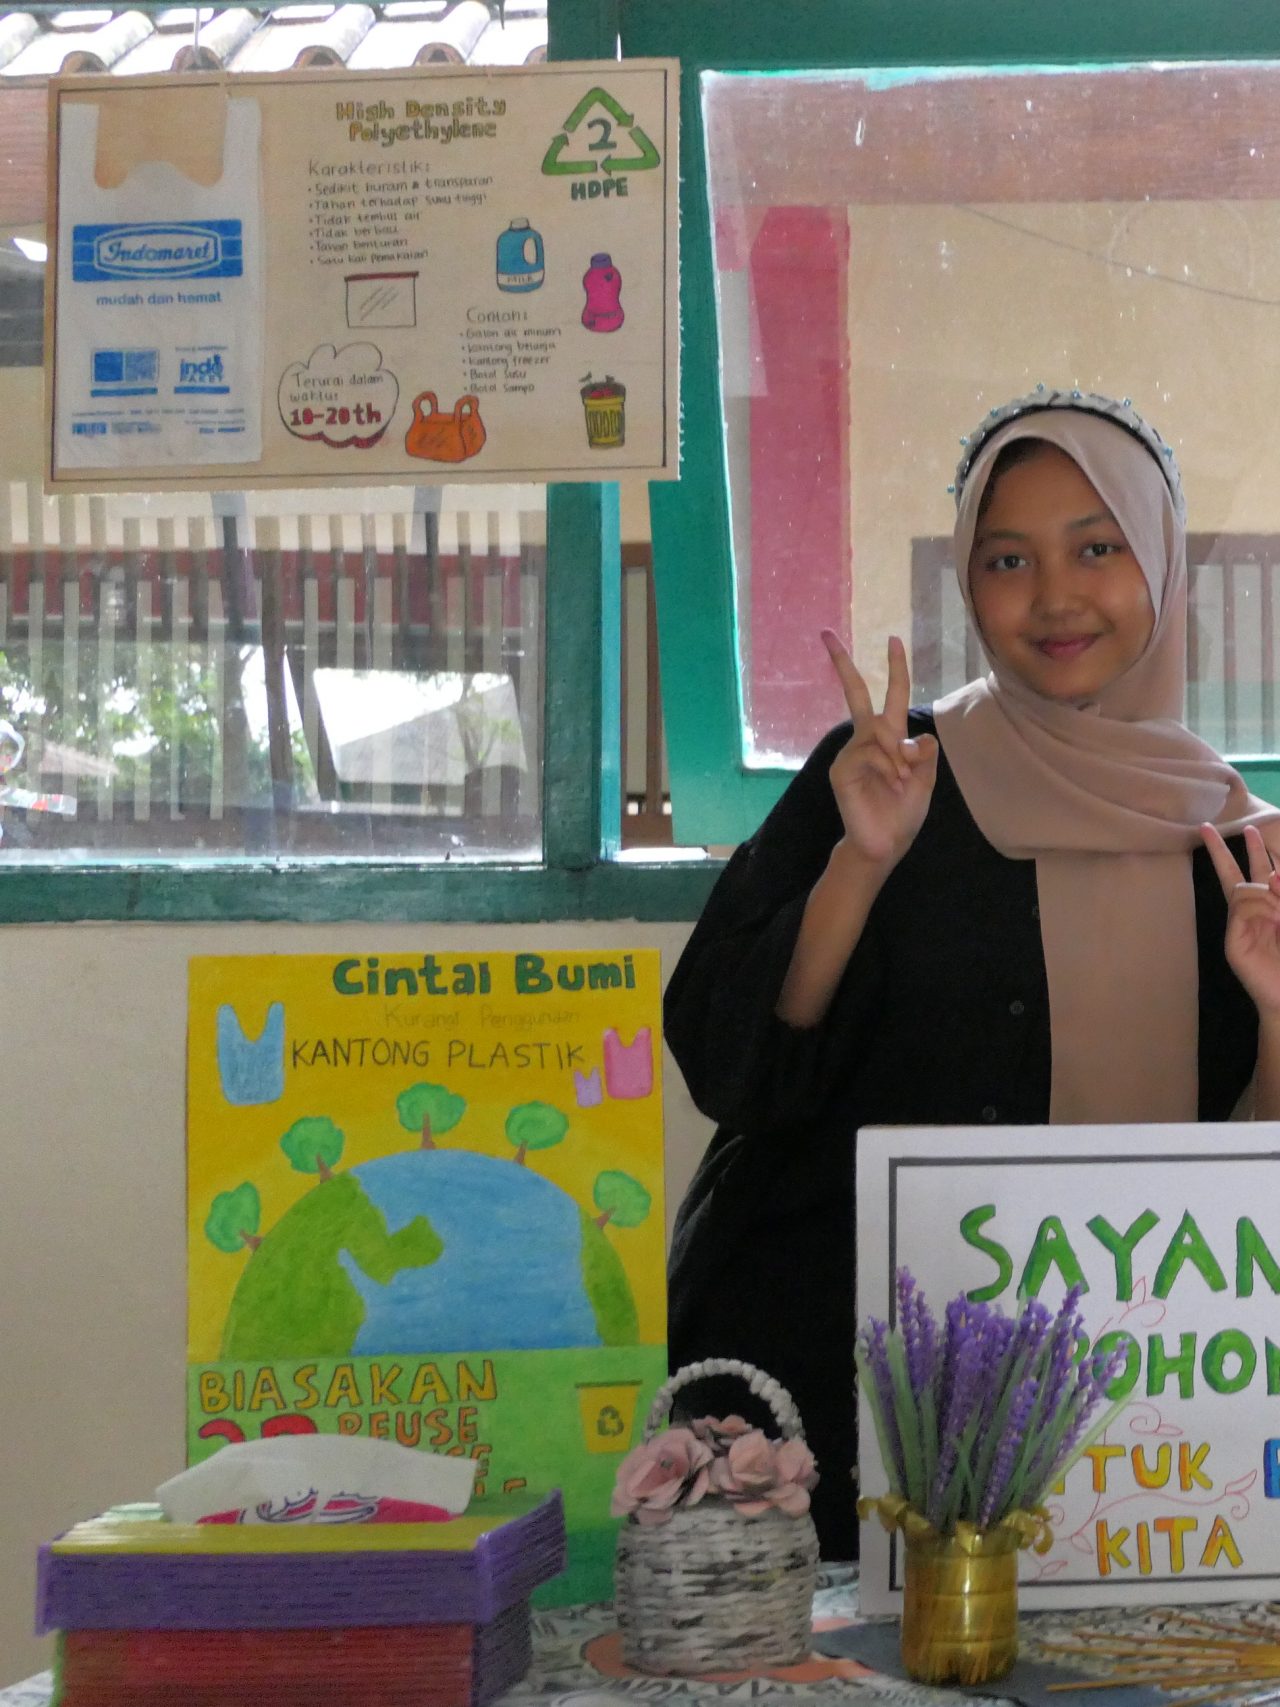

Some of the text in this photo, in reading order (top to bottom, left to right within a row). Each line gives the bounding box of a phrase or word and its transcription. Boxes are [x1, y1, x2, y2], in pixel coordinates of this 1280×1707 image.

[336, 97, 507, 122] High Density
[350, 118, 497, 148] Polyethylene
[587, 117, 617, 151] 2
[571, 177, 628, 201] HDPE
[104, 240, 210, 262] Indomaret
[96, 290, 222, 306] mudah dan hemat
[515, 952, 637, 996] Bumi
[291, 1037, 586, 1070] KANTONG PLASTIK
[199, 1359, 498, 1413] BIASAKAN
[1096, 1514, 1245, 1577] KITA
